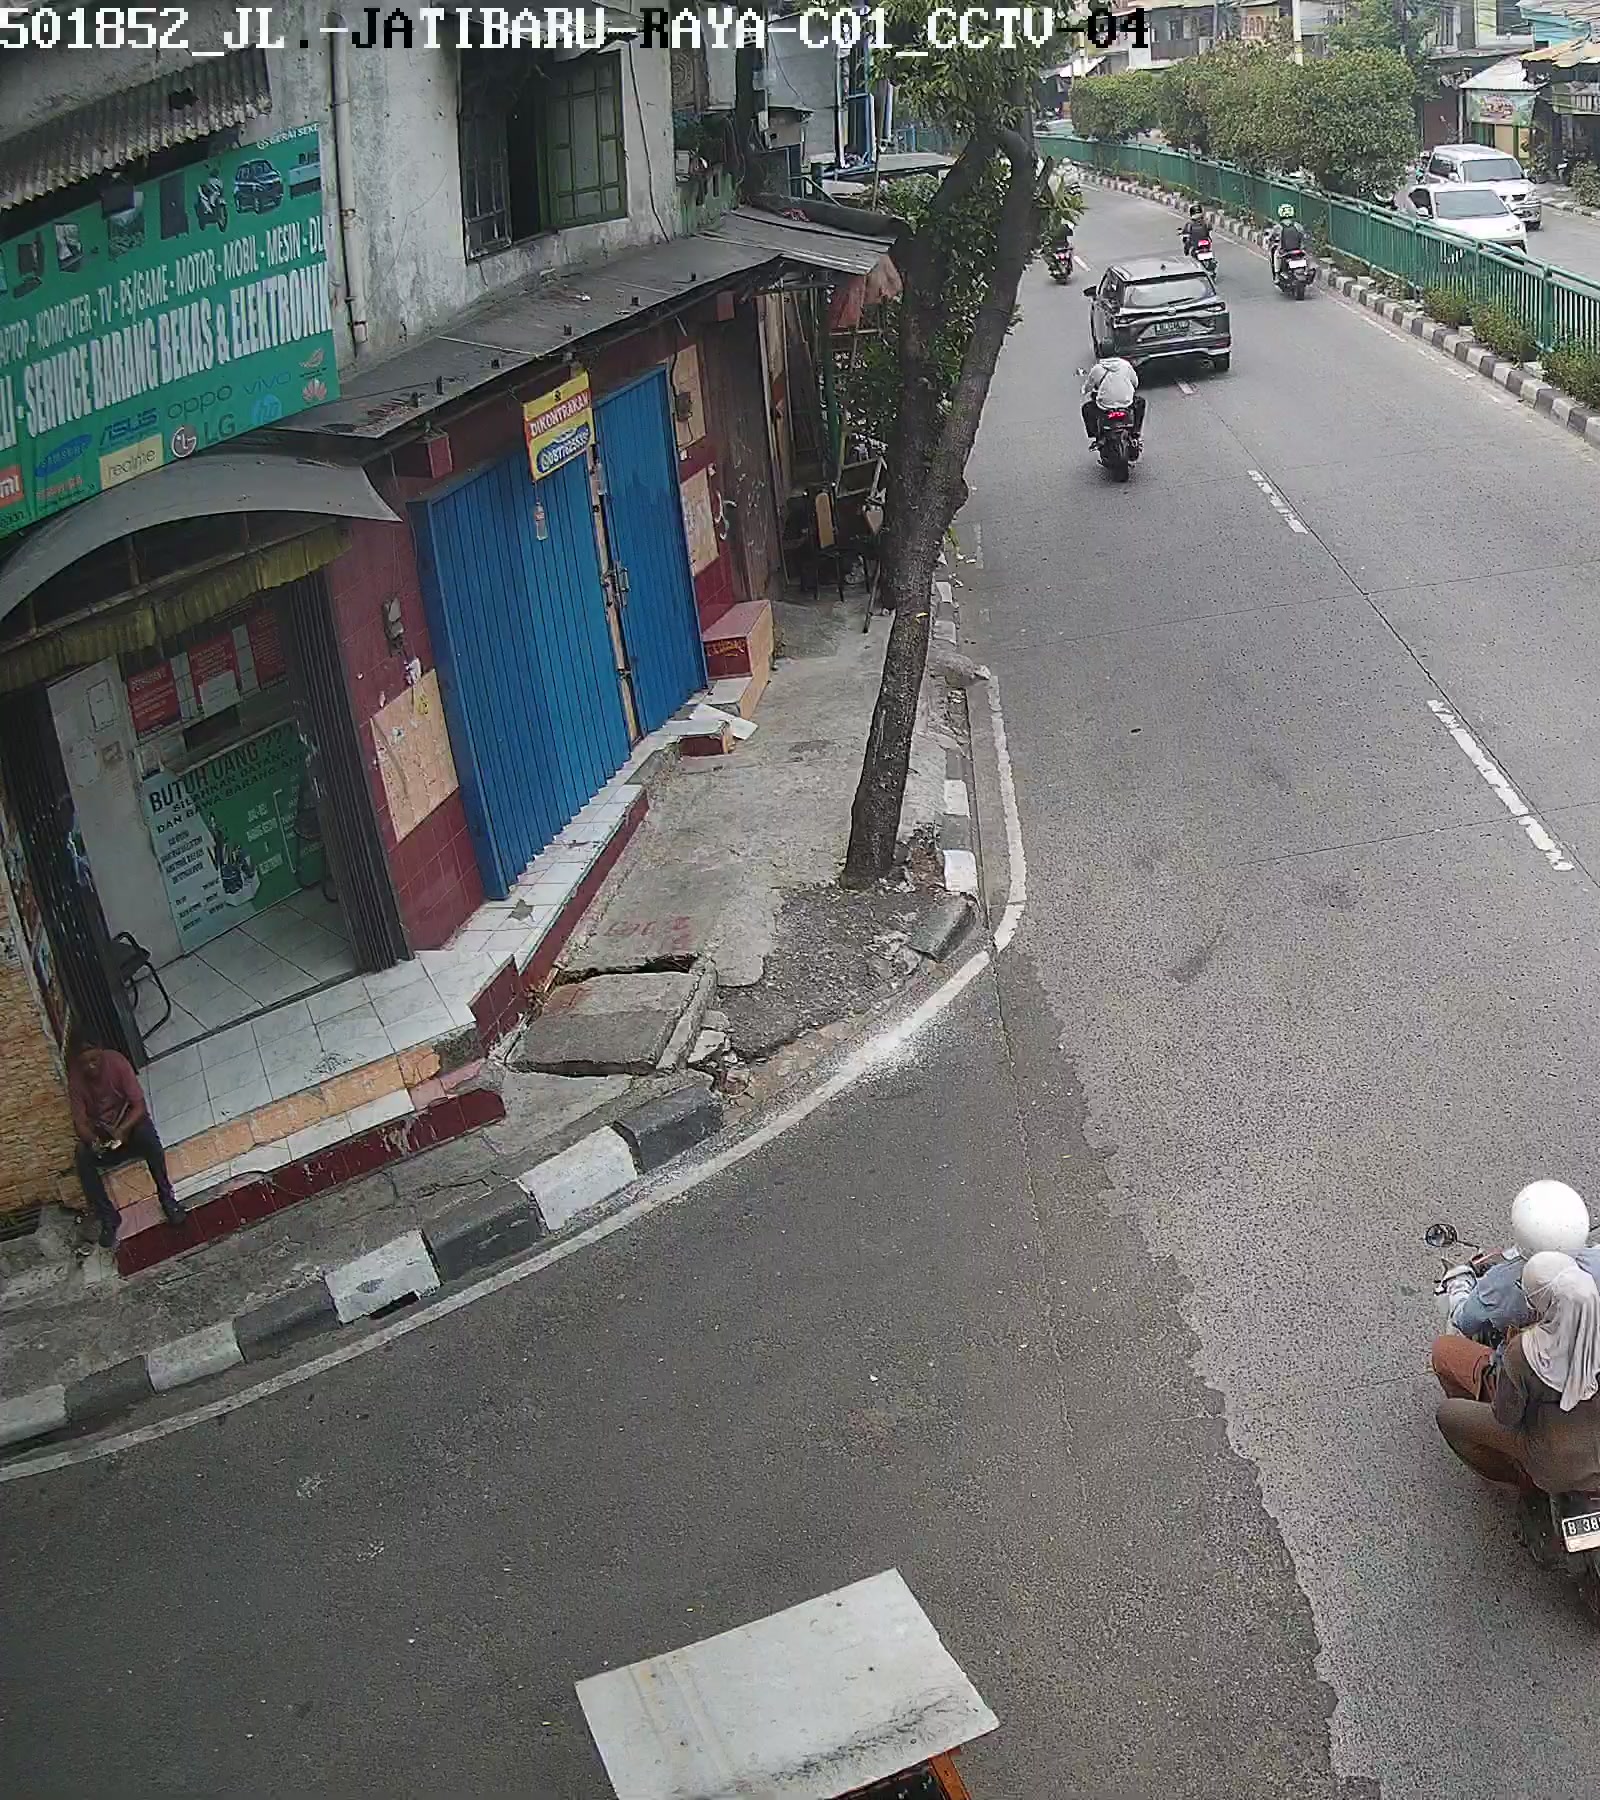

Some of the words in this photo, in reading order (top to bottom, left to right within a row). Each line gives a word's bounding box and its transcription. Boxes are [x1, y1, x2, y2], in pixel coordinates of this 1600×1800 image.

[36, 294, 93, 349] KOMPUTER
[98, 284, 113, 325] TV
[119, 264, 168, 322] PS/GAME
[175, 249, 217, 297] MOTOR
[223, 235, 259, 280] MOBIL
[266, 222, 301, 267] MESIN
[24, 344, 93, 438] SERVICE
[89, 317, 160, 411] BARANG
[157, 298, 214, 385] BEKAS
[215, 303, 231, 365] &
[229, 260, 334, 360] ELEKTRONIK
[529, 390, 590, 437] DIKONTRAKAN
[150, 766, 209, 814] BUTUH
[211, 741, 259, 780] UANG
[157, 814, 183, 835] DAN
[1567, 1521, 1577, 1535] B
